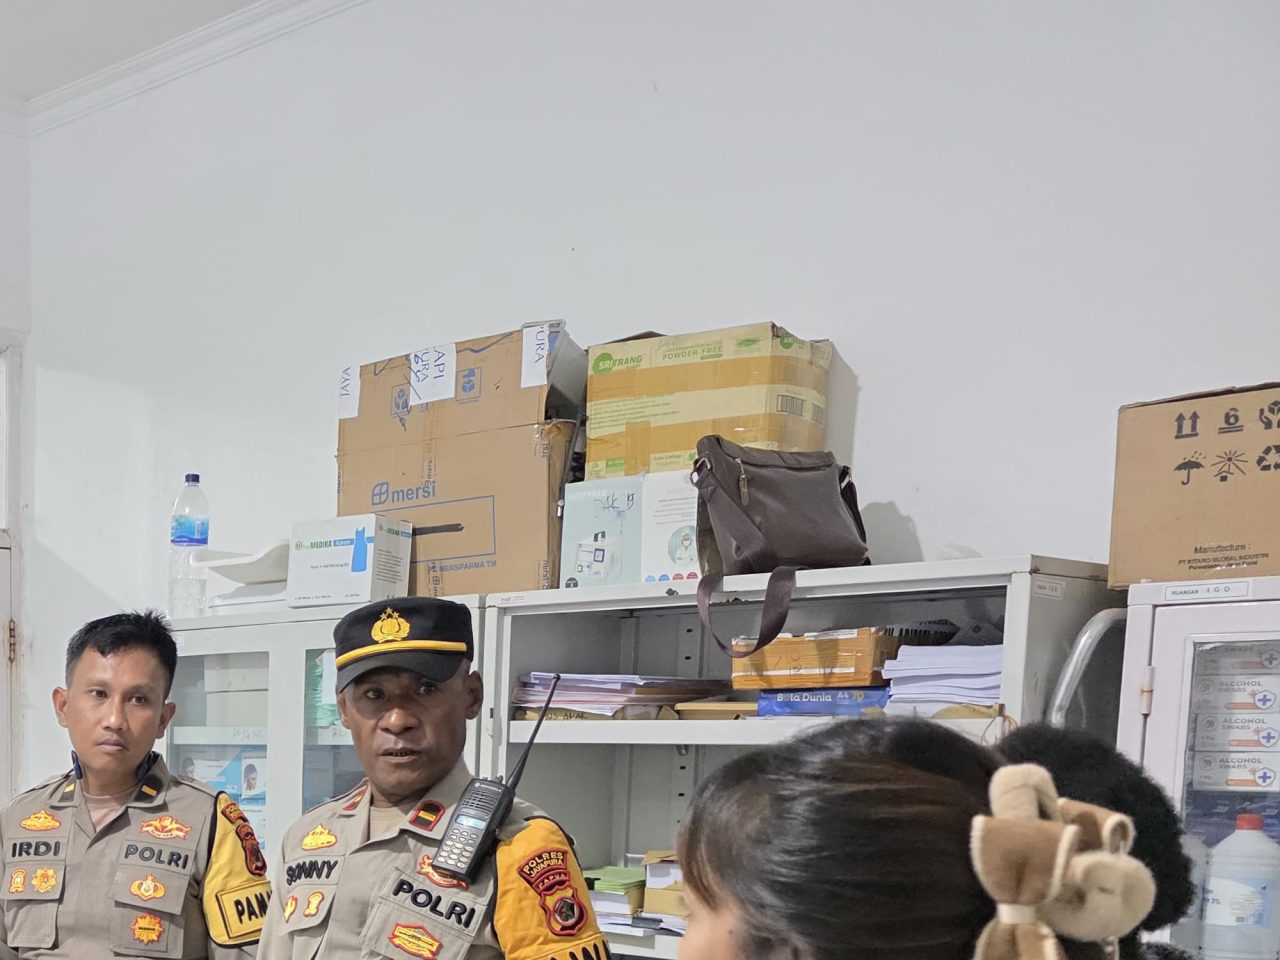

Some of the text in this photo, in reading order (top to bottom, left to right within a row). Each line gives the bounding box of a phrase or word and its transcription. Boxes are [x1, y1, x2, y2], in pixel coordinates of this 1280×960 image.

[433, 346, 446, 380] API
[662, 345, 722, 361] POWDER-FREE
[392, 481, 436, 503] mersi
[802, 692, 832, 702] Dunia
[1222, 717, 1267, 725] ALCOHOL
[11, 841, 61, 858] IRDI
[124, 844, 189, 870] POLRI
[286, 860, 338, 886] SONNY
[522, 851, 564, 874] POLRES
[529, 858, 564, 878] JAYAPURA
[538, 873, 566, 889] PAPUA
[392, 878, 476, 929] POLRI
